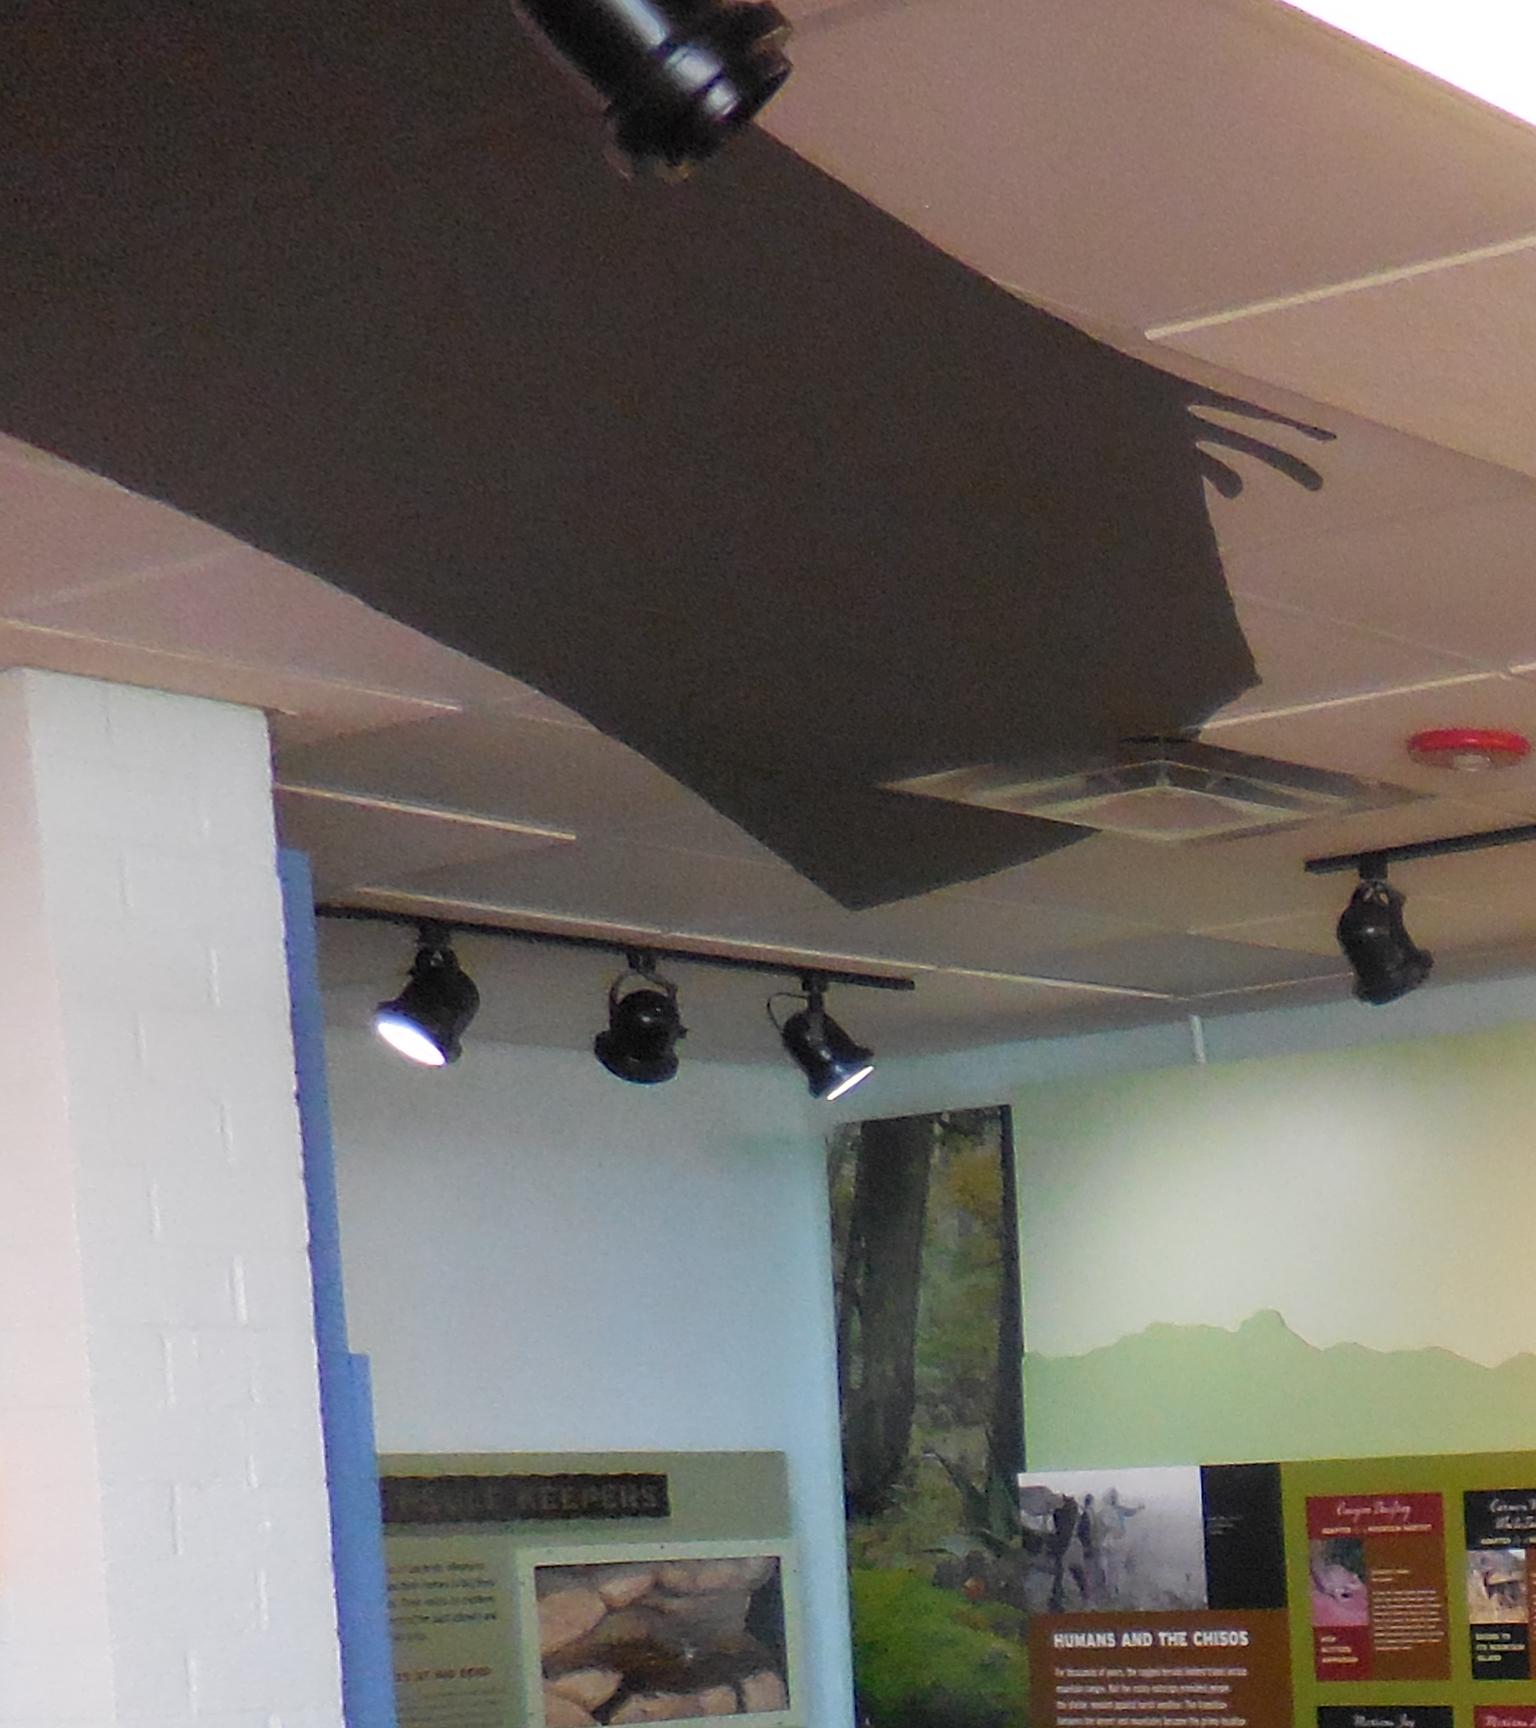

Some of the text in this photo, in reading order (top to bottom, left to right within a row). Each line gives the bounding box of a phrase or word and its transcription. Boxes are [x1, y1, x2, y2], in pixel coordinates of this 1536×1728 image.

[1053, 1630, 1249, 1648] HUMANS AND THE CHISOS
